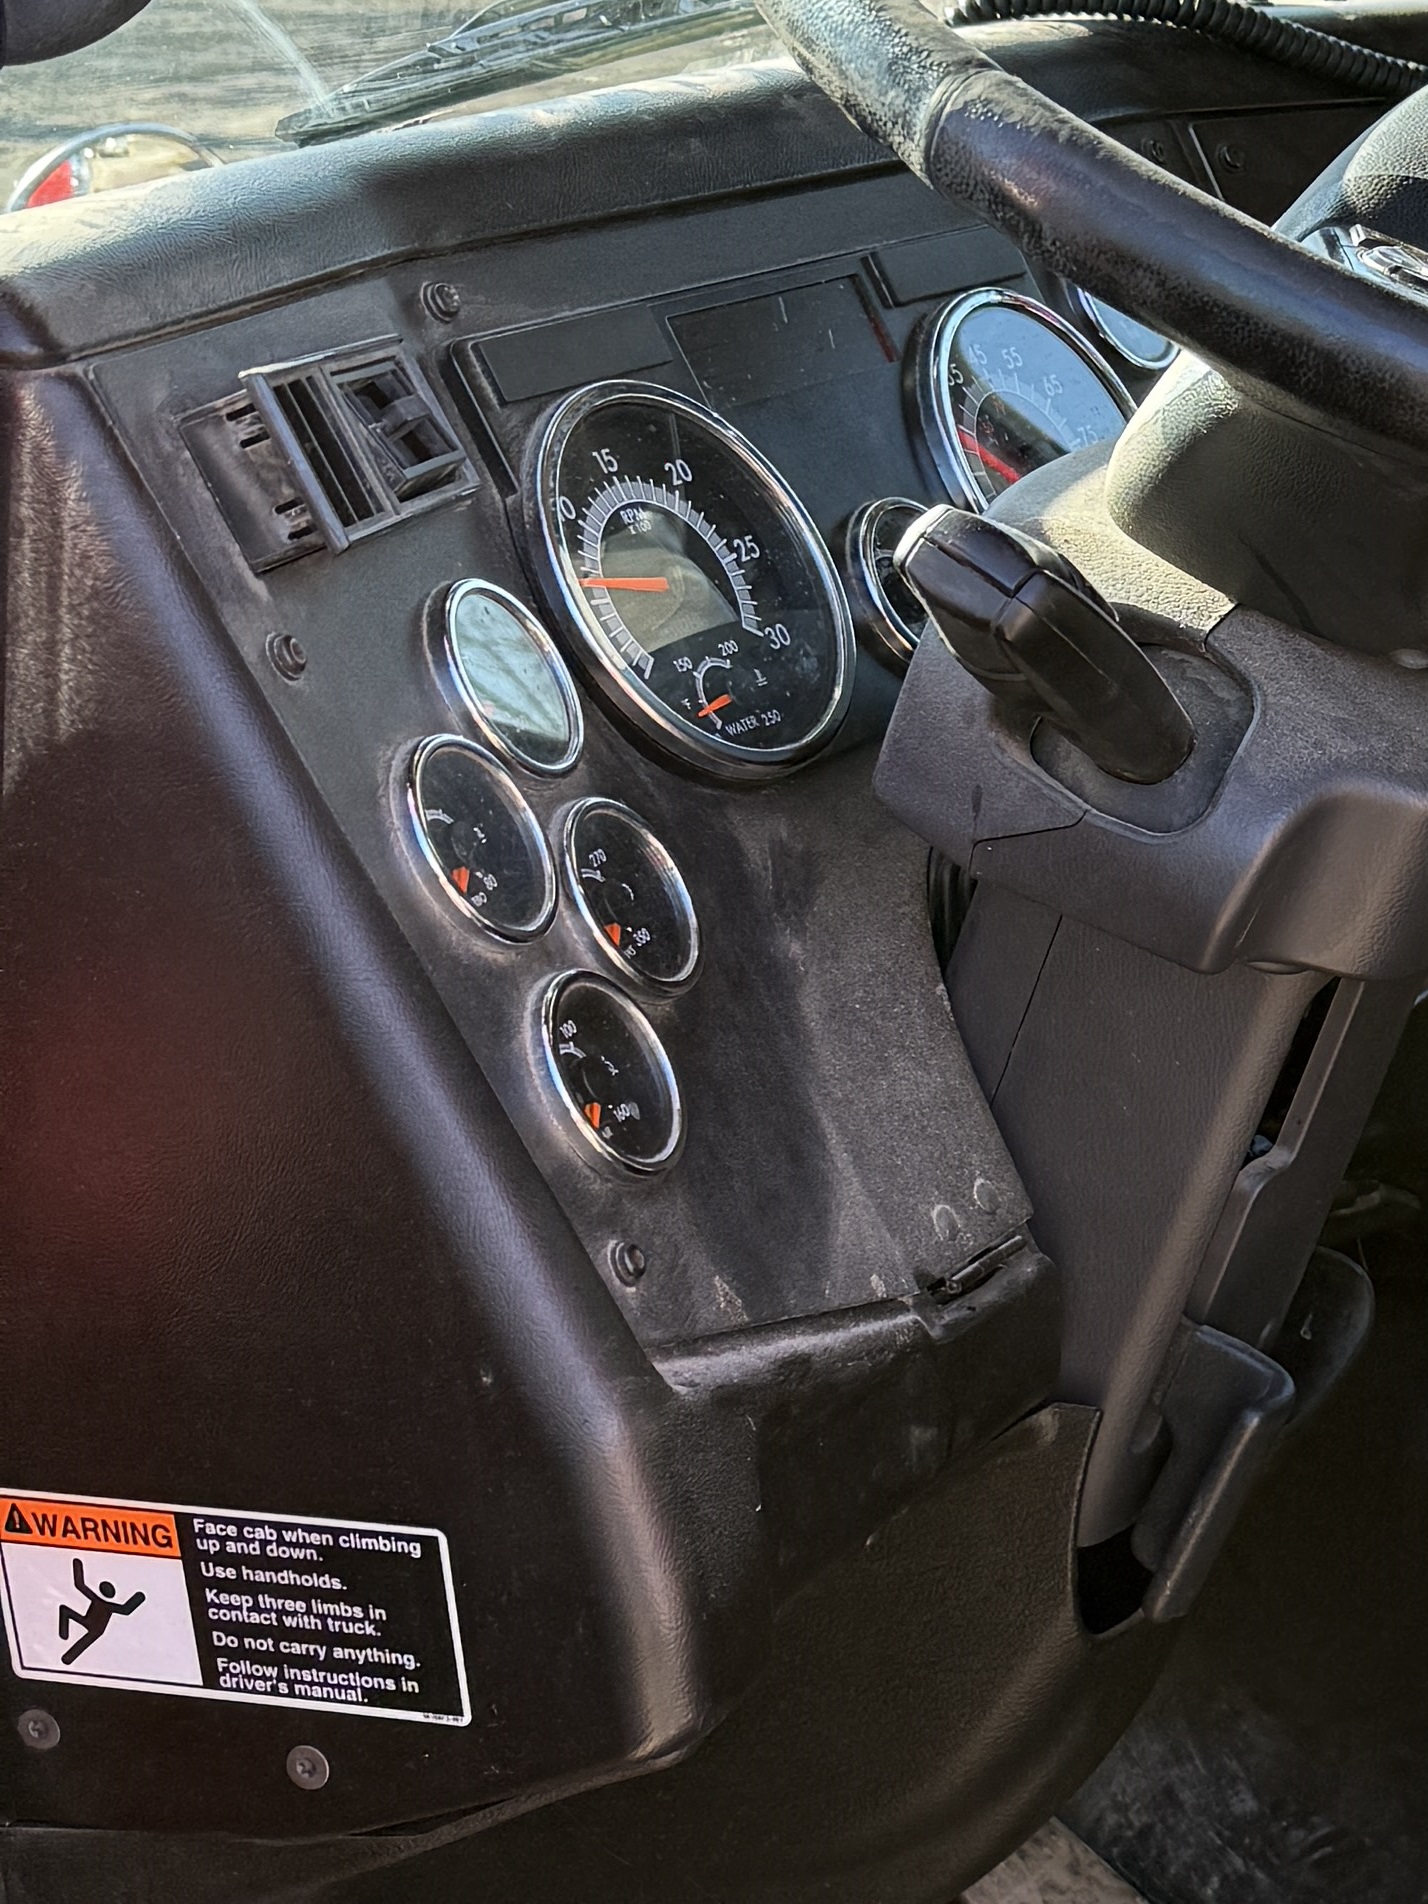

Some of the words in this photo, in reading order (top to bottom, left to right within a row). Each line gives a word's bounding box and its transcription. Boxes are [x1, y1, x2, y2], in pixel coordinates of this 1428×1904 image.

[1003, 347, 1023, 369] 55
[1043, 375, 1063, 397] 65
[1079, 425, 1097, 444] 75
[592, 448, 619, 475] 15
[664, 459, 693, 486] 20
[621, 506, 645, 526] RPM
[733, 535, 760, 563] 25
[718, 640, 739, 656] 200
[764, 623, 791, 650] 30
[673, 657, 693, 673] 150
[725, 716, 761, 737] WATER
[761, 709, 782, 728] 250
[30, 1511, 173, 1549] WARNING
[192, 1517, 238, 1538] Face
[242, 1522, 278, 1541] cab
[281, 1527, 334, 1547] when
[337, 1531, 423, 1559] climbing
[195, 1537, 221, 1555] up
[224, 1537, 260, 1556] and
[264, 1541, 324, 1562] down.
[200, 1560, 237, 1580] Use
[241, 1565, 348, 1591] handholds.
[204, 1587, 254, 1610] Keep
[257, 1593, 307, 1613] three
[310, 1598, 364, 1618] limbs
[368, 1604, 387, 1621] in
[207, 1604, 278, 1626] contact
[281, 1611, 322, 1631] with
[326, 1616, 382, 1637] truck.
[211, 1630, 238, 1648] Do
[243, 1634, 275, 1652] not
[278, 1638, 328, 1661] carry
[331, 1643, 421, 1671] anything.
[216, 1656, 278, 1679] Follow
[282, 1663, 396, 1691] instructions
[399, 1675, 420, 1694] in
[218, 1673, 289, 1695] driver's
[293, 1680, 369, 1703] manual.
